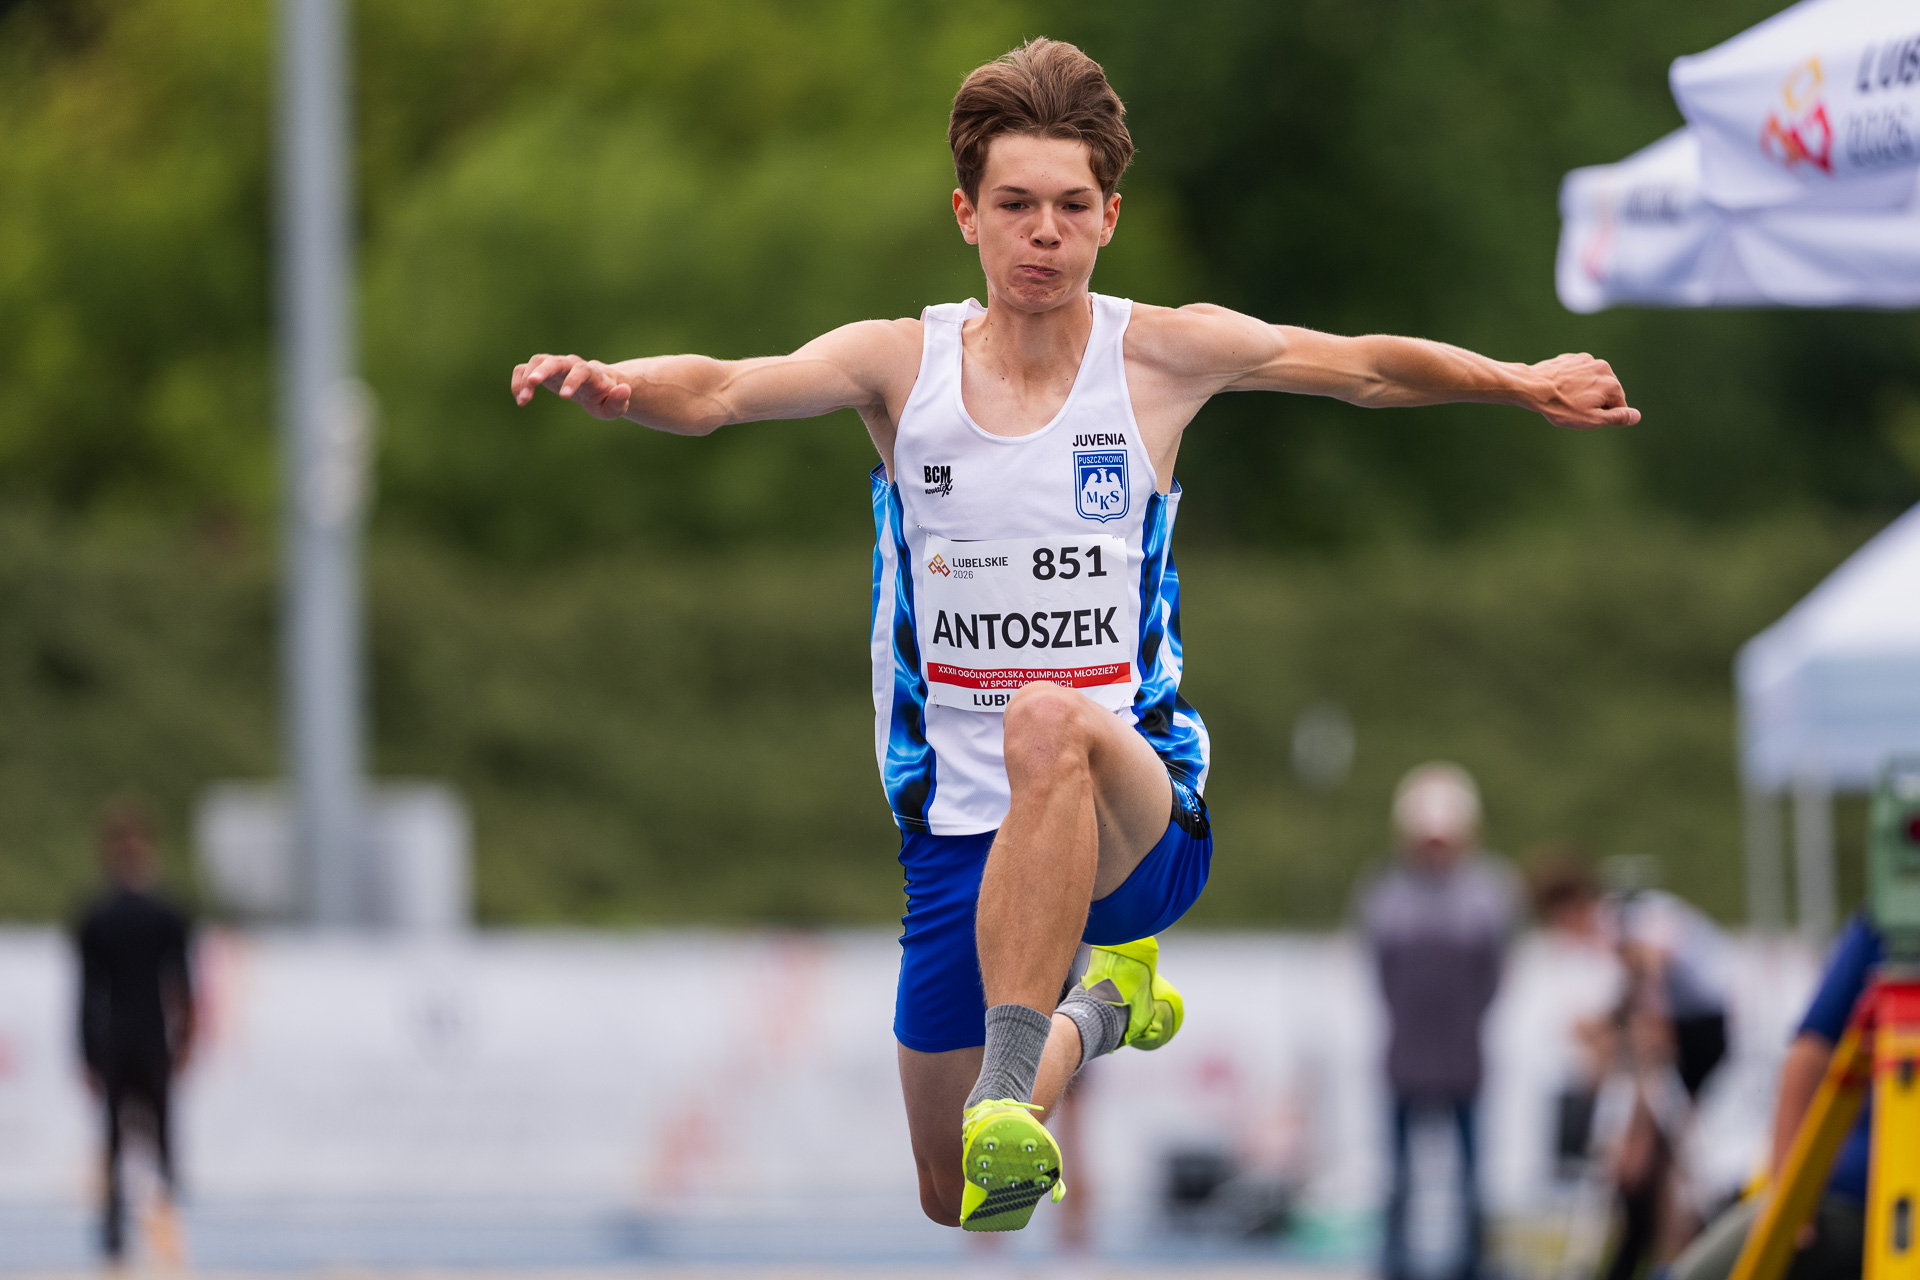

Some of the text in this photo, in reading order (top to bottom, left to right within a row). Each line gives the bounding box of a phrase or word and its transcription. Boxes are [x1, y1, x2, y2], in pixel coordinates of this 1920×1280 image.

[1072, 433, 1127, 447] JUVENIA
[1078, 455, 1123, 465] PUSZCZYKOWO
[924, 465, 952, 484] BCM
[1086, 490, 1120, 510] MKS
[952, 556, 1008, 568] LUBELSKIE
[1032, 545, 1107, 581] 851
[953, 570, 974, 580] 2026
[932, 606, 1120, 650] ANTOSZEK
[938, 665, 1120, 680] XXXII OGÓLNOPOLSKA OLIMPIADA MŁODZIEŻY
[979, 680, 988, 688] W
[990, 680, 1032, 688] SPORTAC
